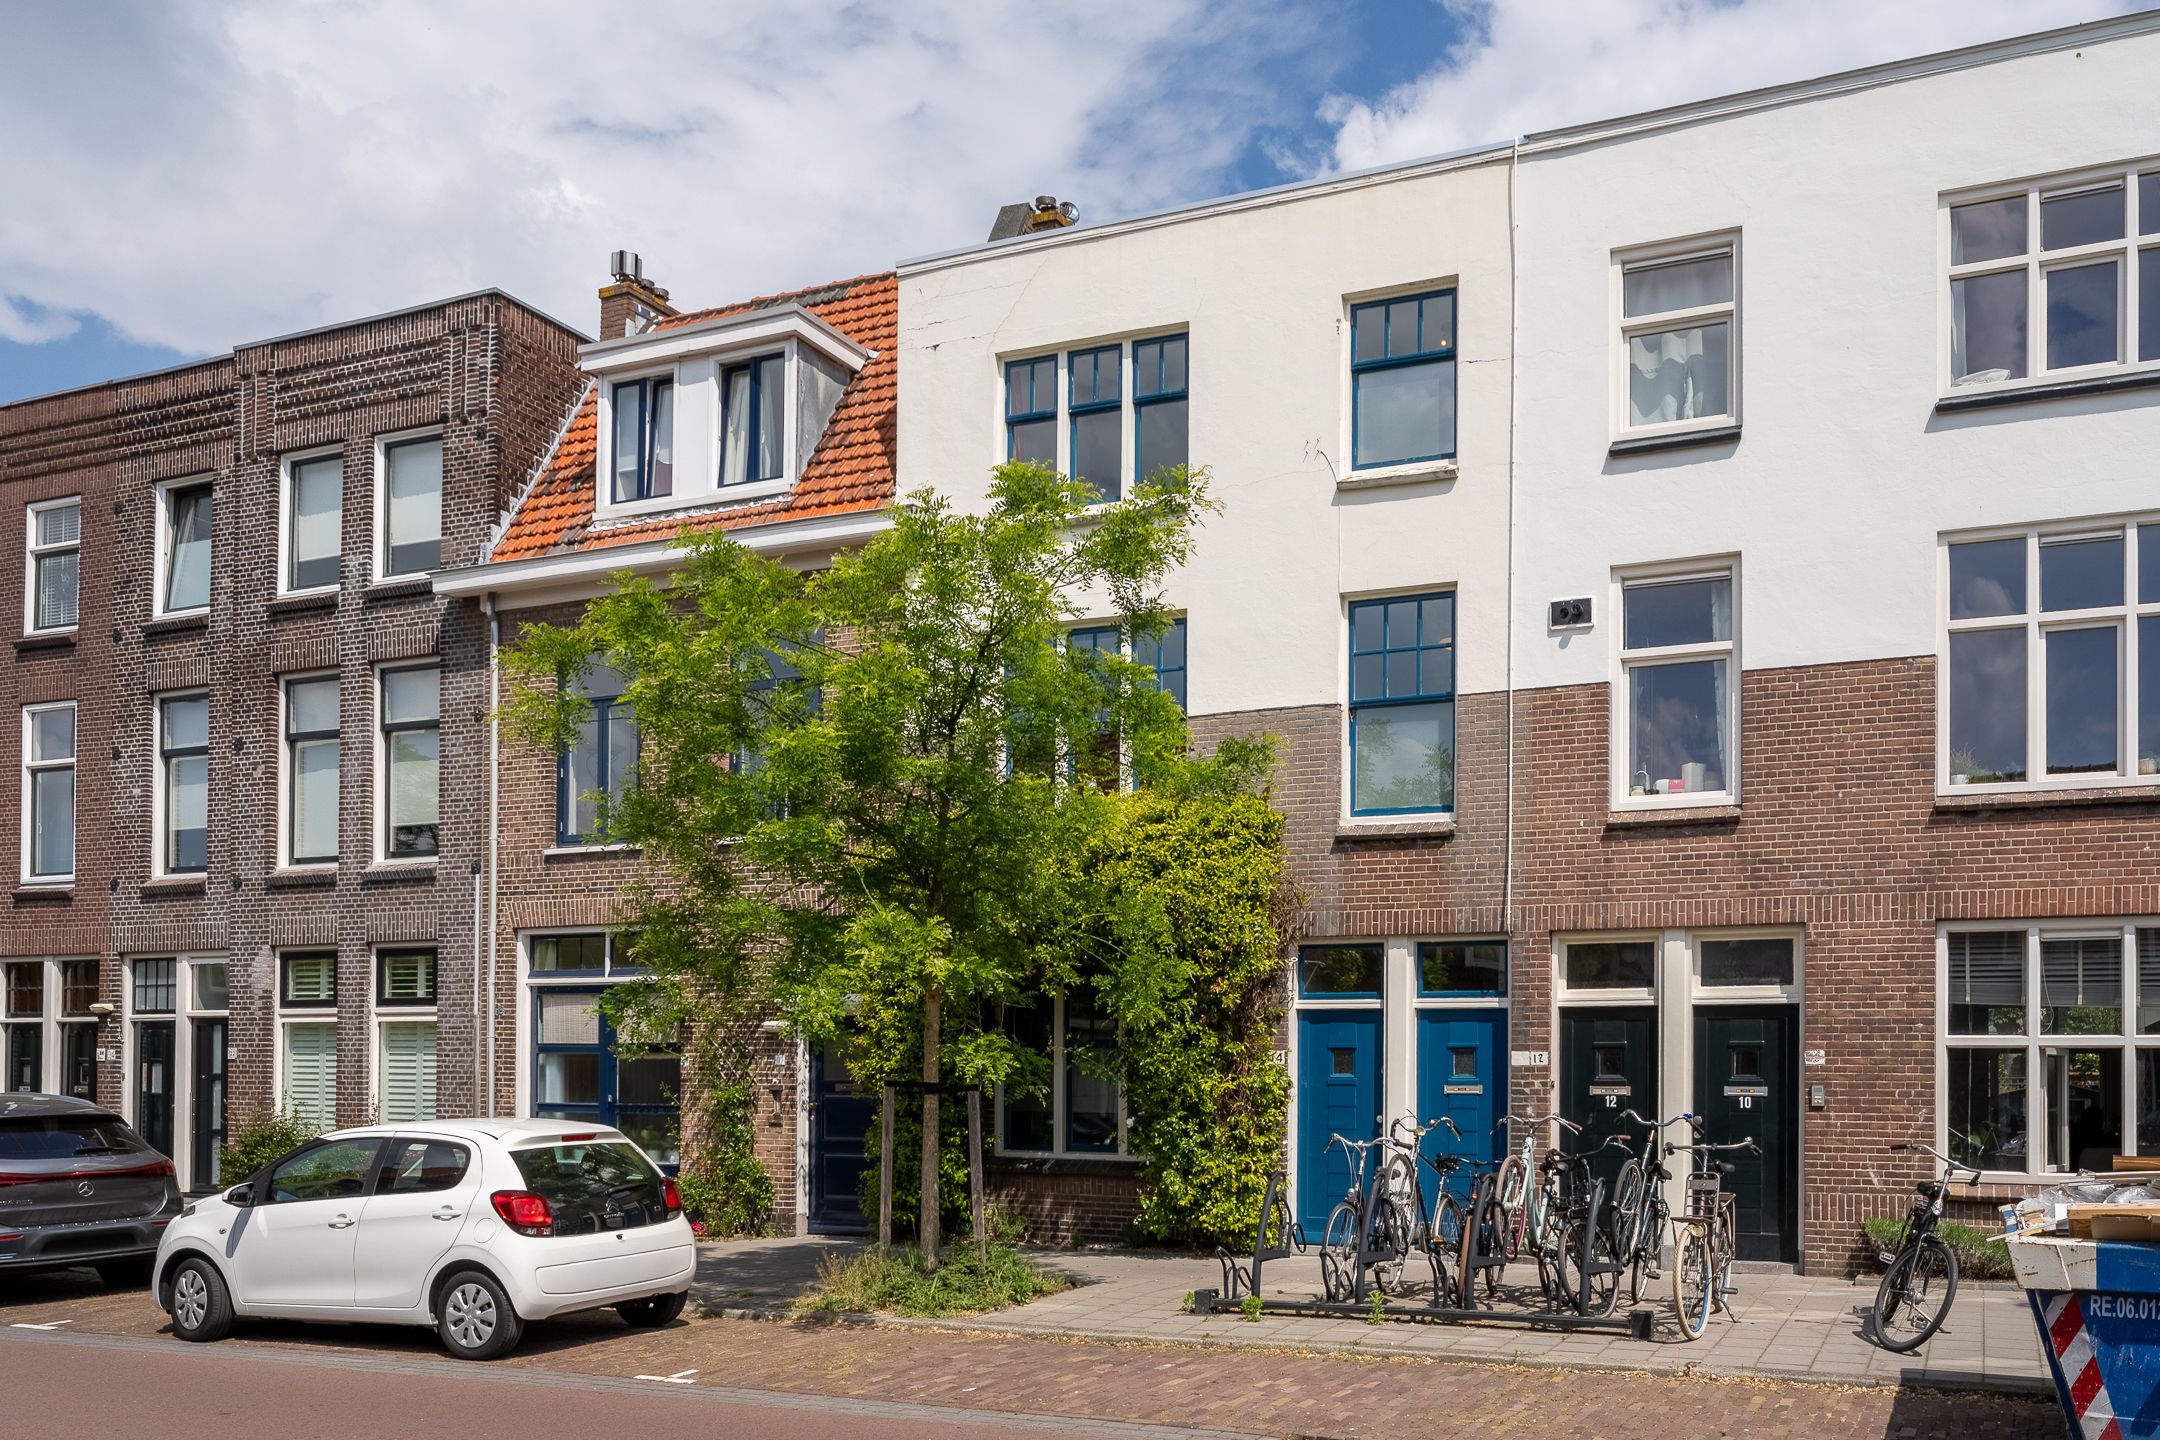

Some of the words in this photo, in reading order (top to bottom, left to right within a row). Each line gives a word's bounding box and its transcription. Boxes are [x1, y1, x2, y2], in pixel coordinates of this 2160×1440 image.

[1533, 1053, 1544, 1063] 12
[1605, 1095, 1617, 1108] 12
[1738, 1096, 1752, 1109] 10
